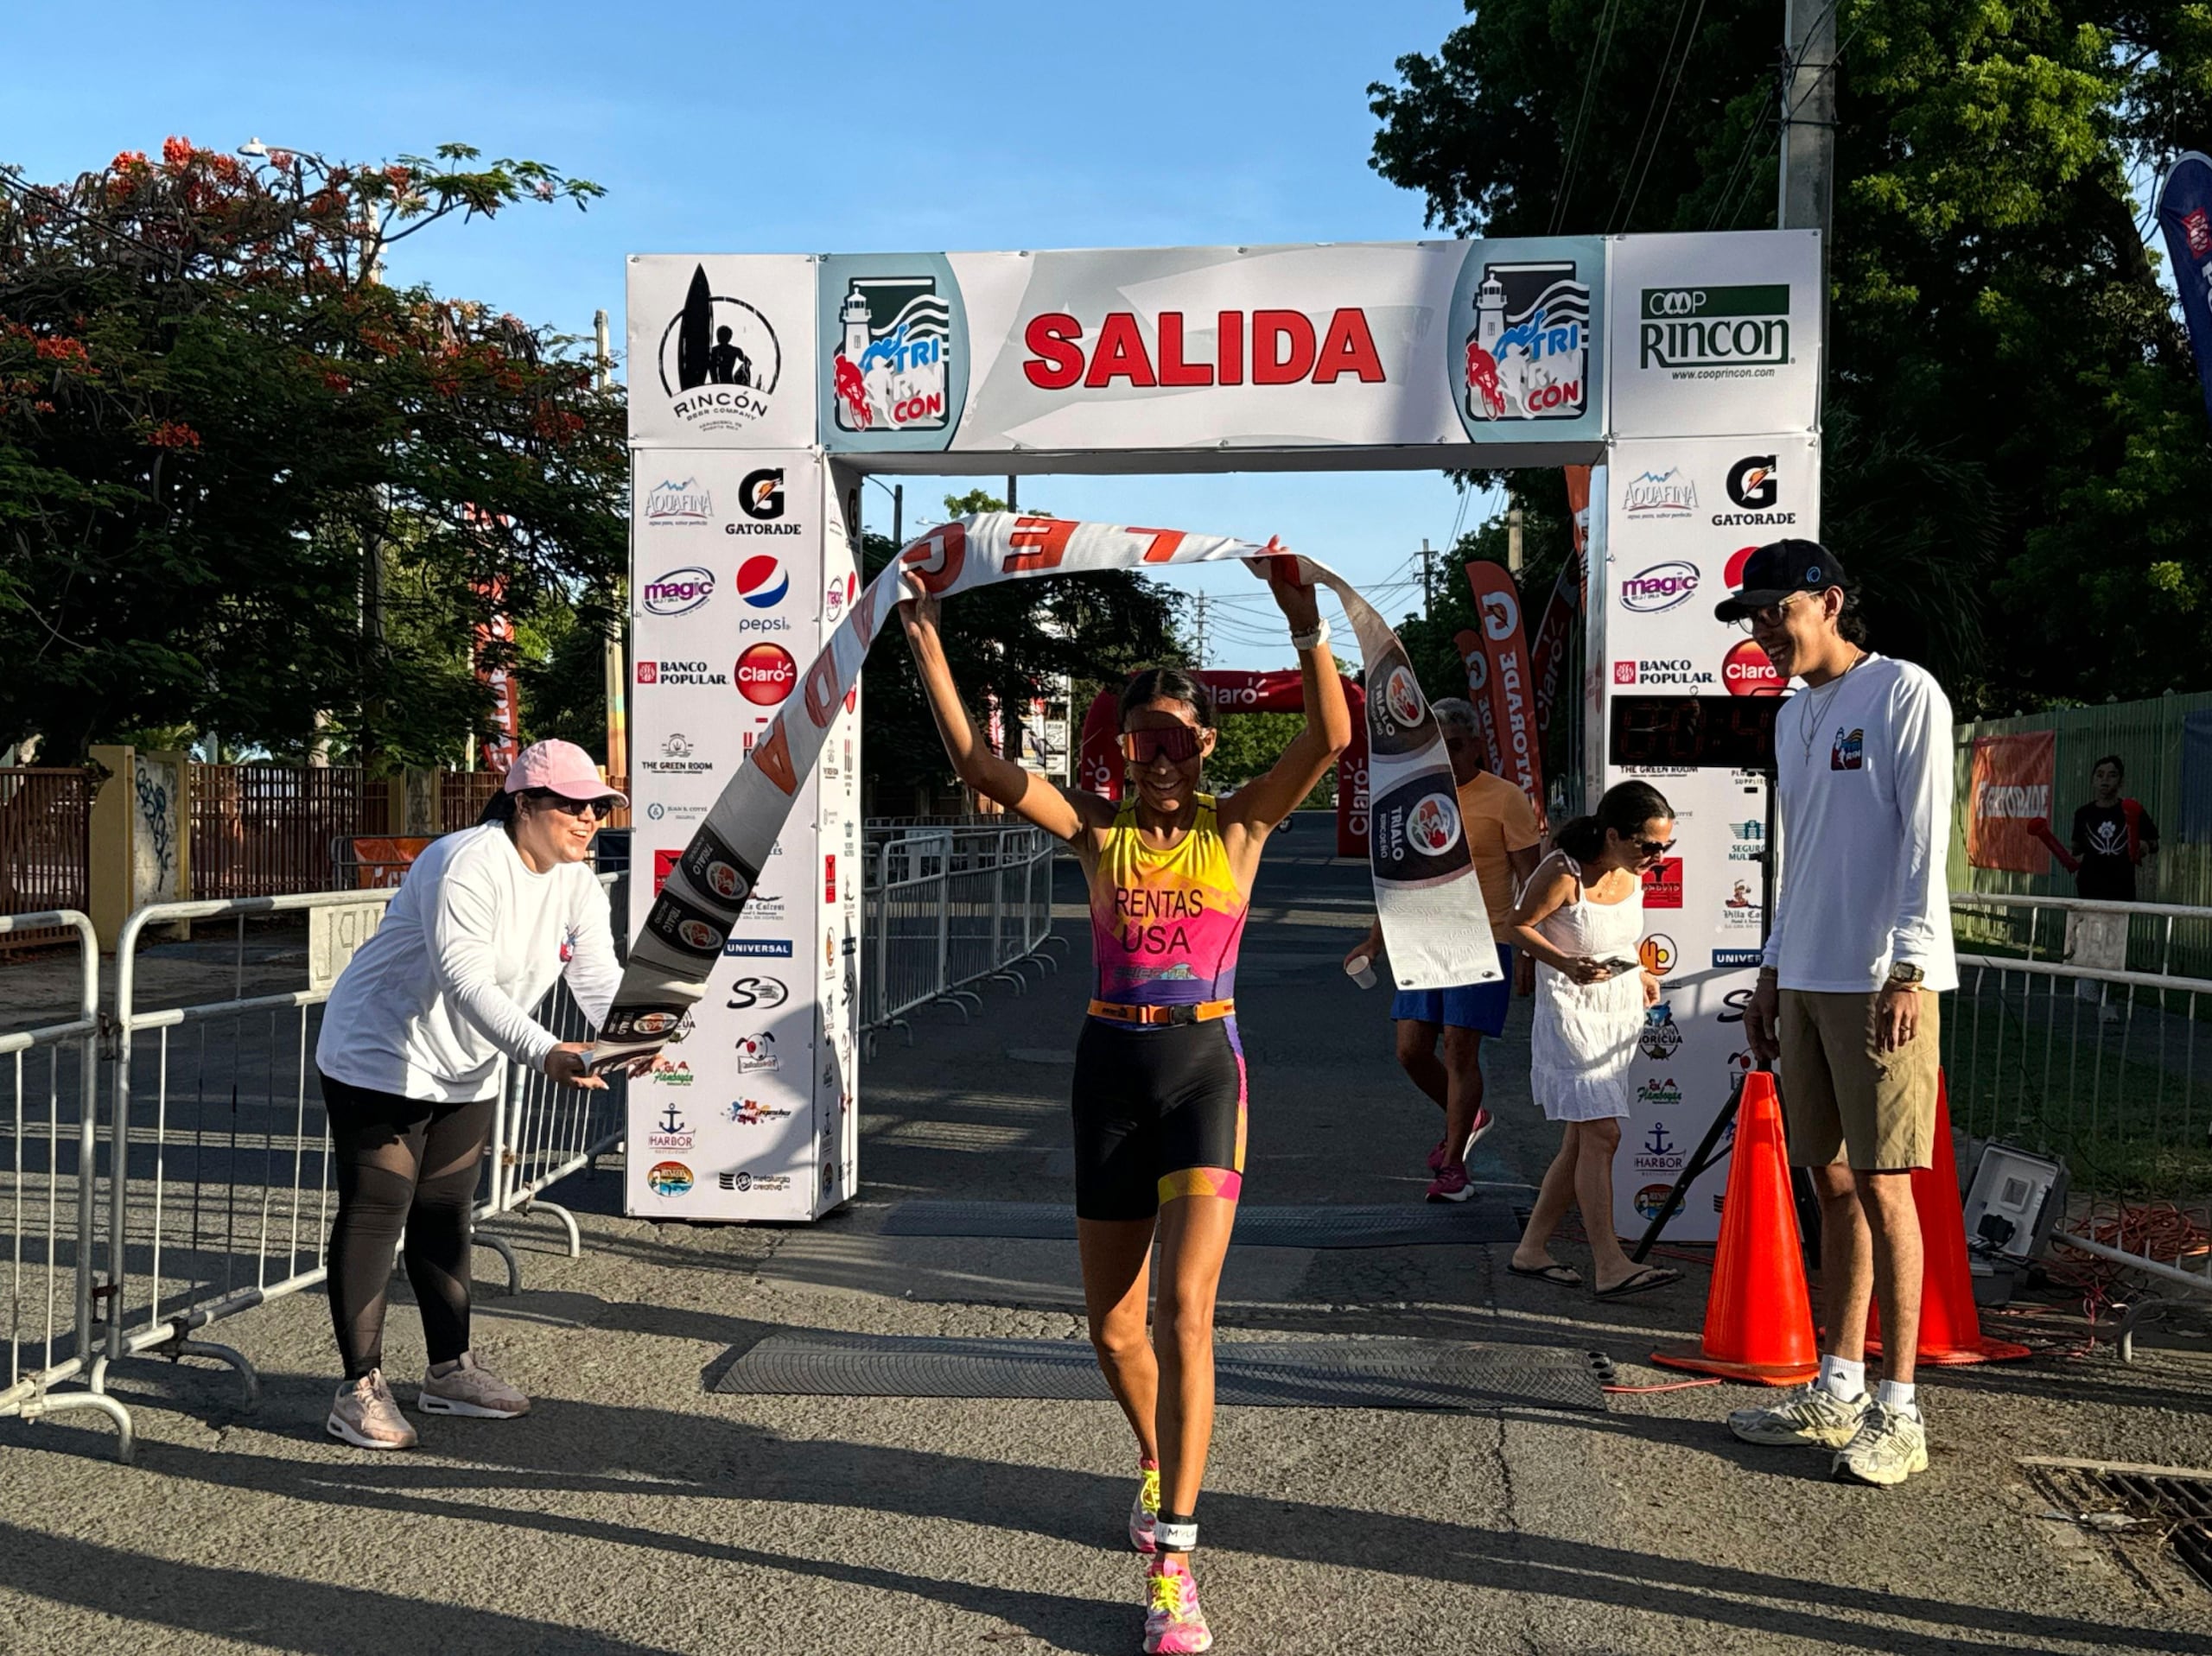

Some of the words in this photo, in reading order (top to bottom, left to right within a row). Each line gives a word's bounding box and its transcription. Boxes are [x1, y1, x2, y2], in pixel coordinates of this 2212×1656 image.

[1023, 308, 1387, 390] SALIDA
[1529, 325, 1580, 360] TRI
[893, 338, 939, 373] TRI
[1671, 368, 1776, 381] www.cooprincon.com
[674, 390, 768, 418] RINCÓN
[686, 409, 710, 422] BEER
[713, 408, 757, 422] COMPANY
[644, 490, 715, 516] AQUAFINA
[1622, 480, 1700, 510] AQUAFINA
[1712, 513, 1796, 526] GATORADE
[726, 524, 802, 535] GATORADE
[644, 578, 715, 600] magic
[1622, 572, 1699, 598] magic
[739, 616, 786, 633] pepsi
[660, 663, 708, 672] BANCO
[1640, 660, 1692, 671] BANCO
[1726, 663, 1777, 679] Claro
[660, 674, 727, 685] POPULAR
[738, 666, 785, 682] Claro
[1640, 672, 1713, 684] POPULAR
[1200, 684, 1258, 704] laro
[642, 761, 658, 770] THE
[1349, 769, 1370, 835] Claro
[1390, 804, 1405, 862] TRÍALO
[1115, 887, 1204, 918] RENTAS
[1122, 925, 1192, 955] USA
[727, 943, 789, 954] UNIVERSAL
[1638, 1035, 1683, 1044] ORICUA
[650, 1136, 692, 1146] HARBOR
[1636, 1158, 1683, 1168] HARBOR
